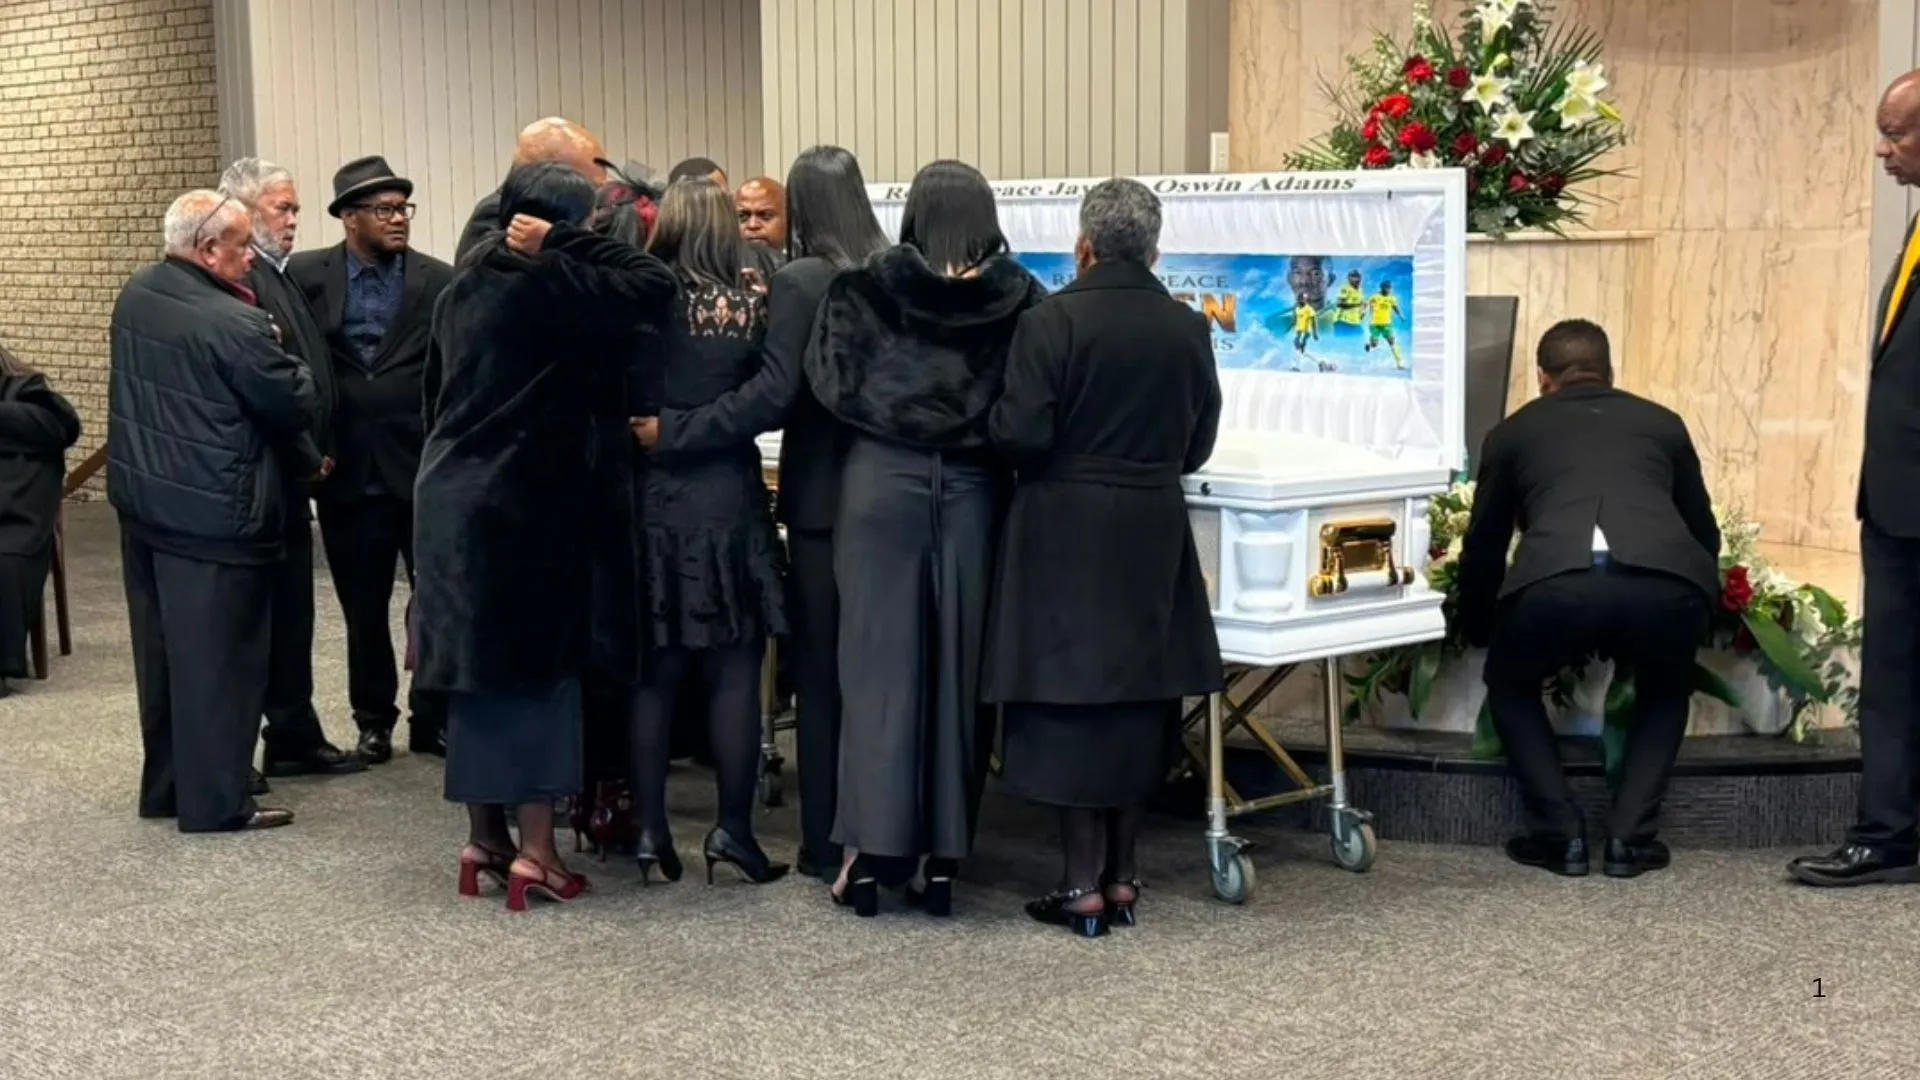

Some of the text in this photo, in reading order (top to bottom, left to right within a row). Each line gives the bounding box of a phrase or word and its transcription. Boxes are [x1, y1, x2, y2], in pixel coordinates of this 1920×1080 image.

[1153, 177, 1242, 194] Oswin
[1250, 176, 1358, 192] Adams
[1159, 275, 1229, 289] EACE
